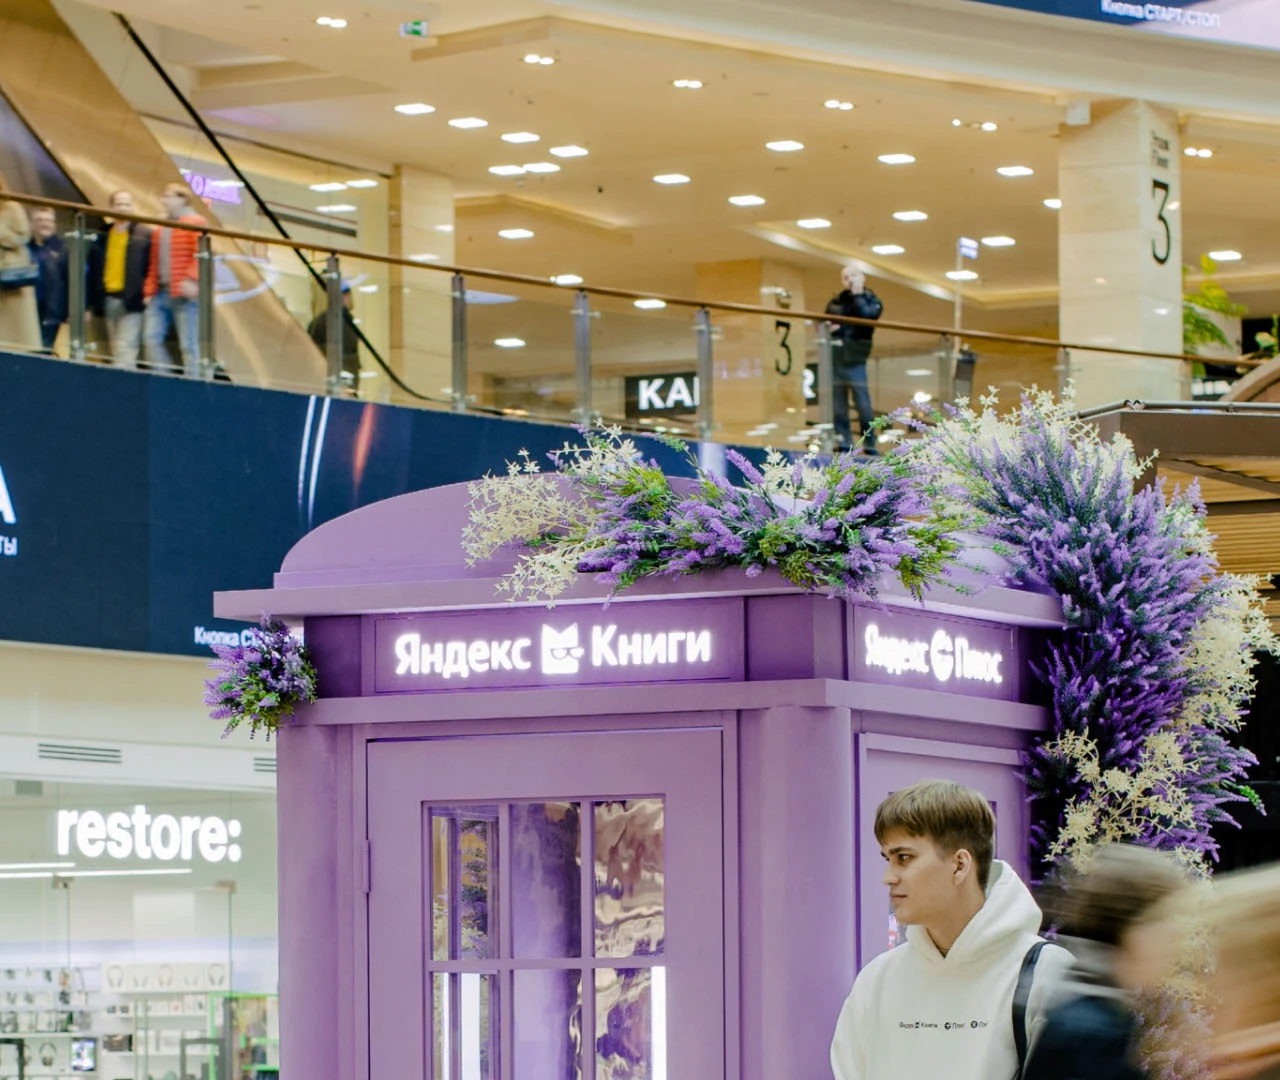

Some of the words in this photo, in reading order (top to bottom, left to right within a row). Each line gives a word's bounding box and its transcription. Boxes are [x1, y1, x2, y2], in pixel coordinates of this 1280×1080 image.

[1152, 179, 1171, 265] 3
[775, 320, 792, 376] 3
[395, 633, 532, 679] Яндекс
[592, 624, 712, 666] Книги
[865, 624, 930, 675] Яндекс
[57, 804, 242, 862] restore:
